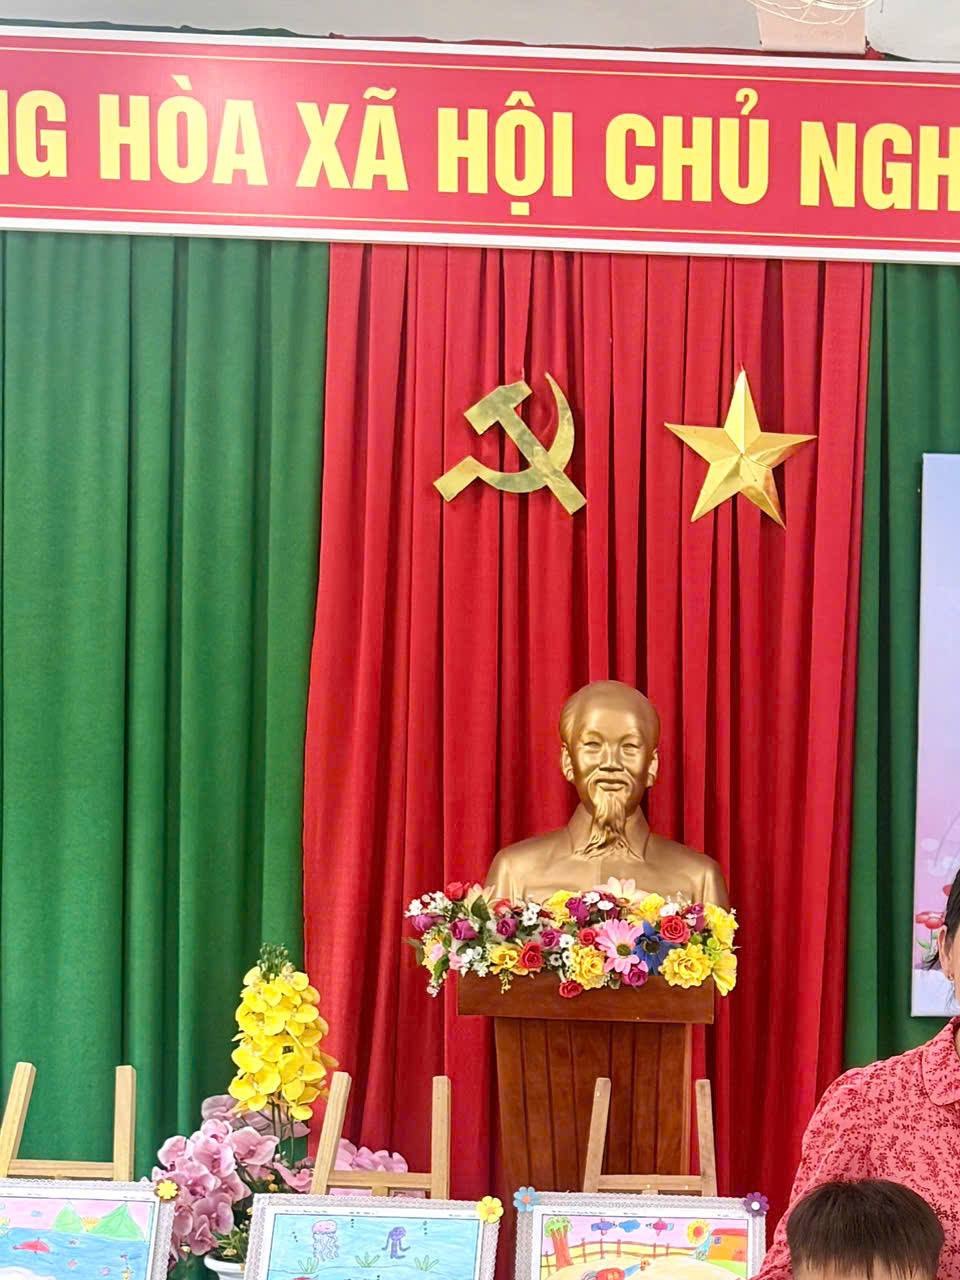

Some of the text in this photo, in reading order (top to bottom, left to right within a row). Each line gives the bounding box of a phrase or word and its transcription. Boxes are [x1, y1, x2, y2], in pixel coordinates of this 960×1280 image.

[0, 90, 66, 177] G
[100, 75, 268, 186] HÒA
[296, 87, 408, 190] XÃ
[438, 92, 572, 215] HỘI
[606, 88, 768, 204] CHỦ
